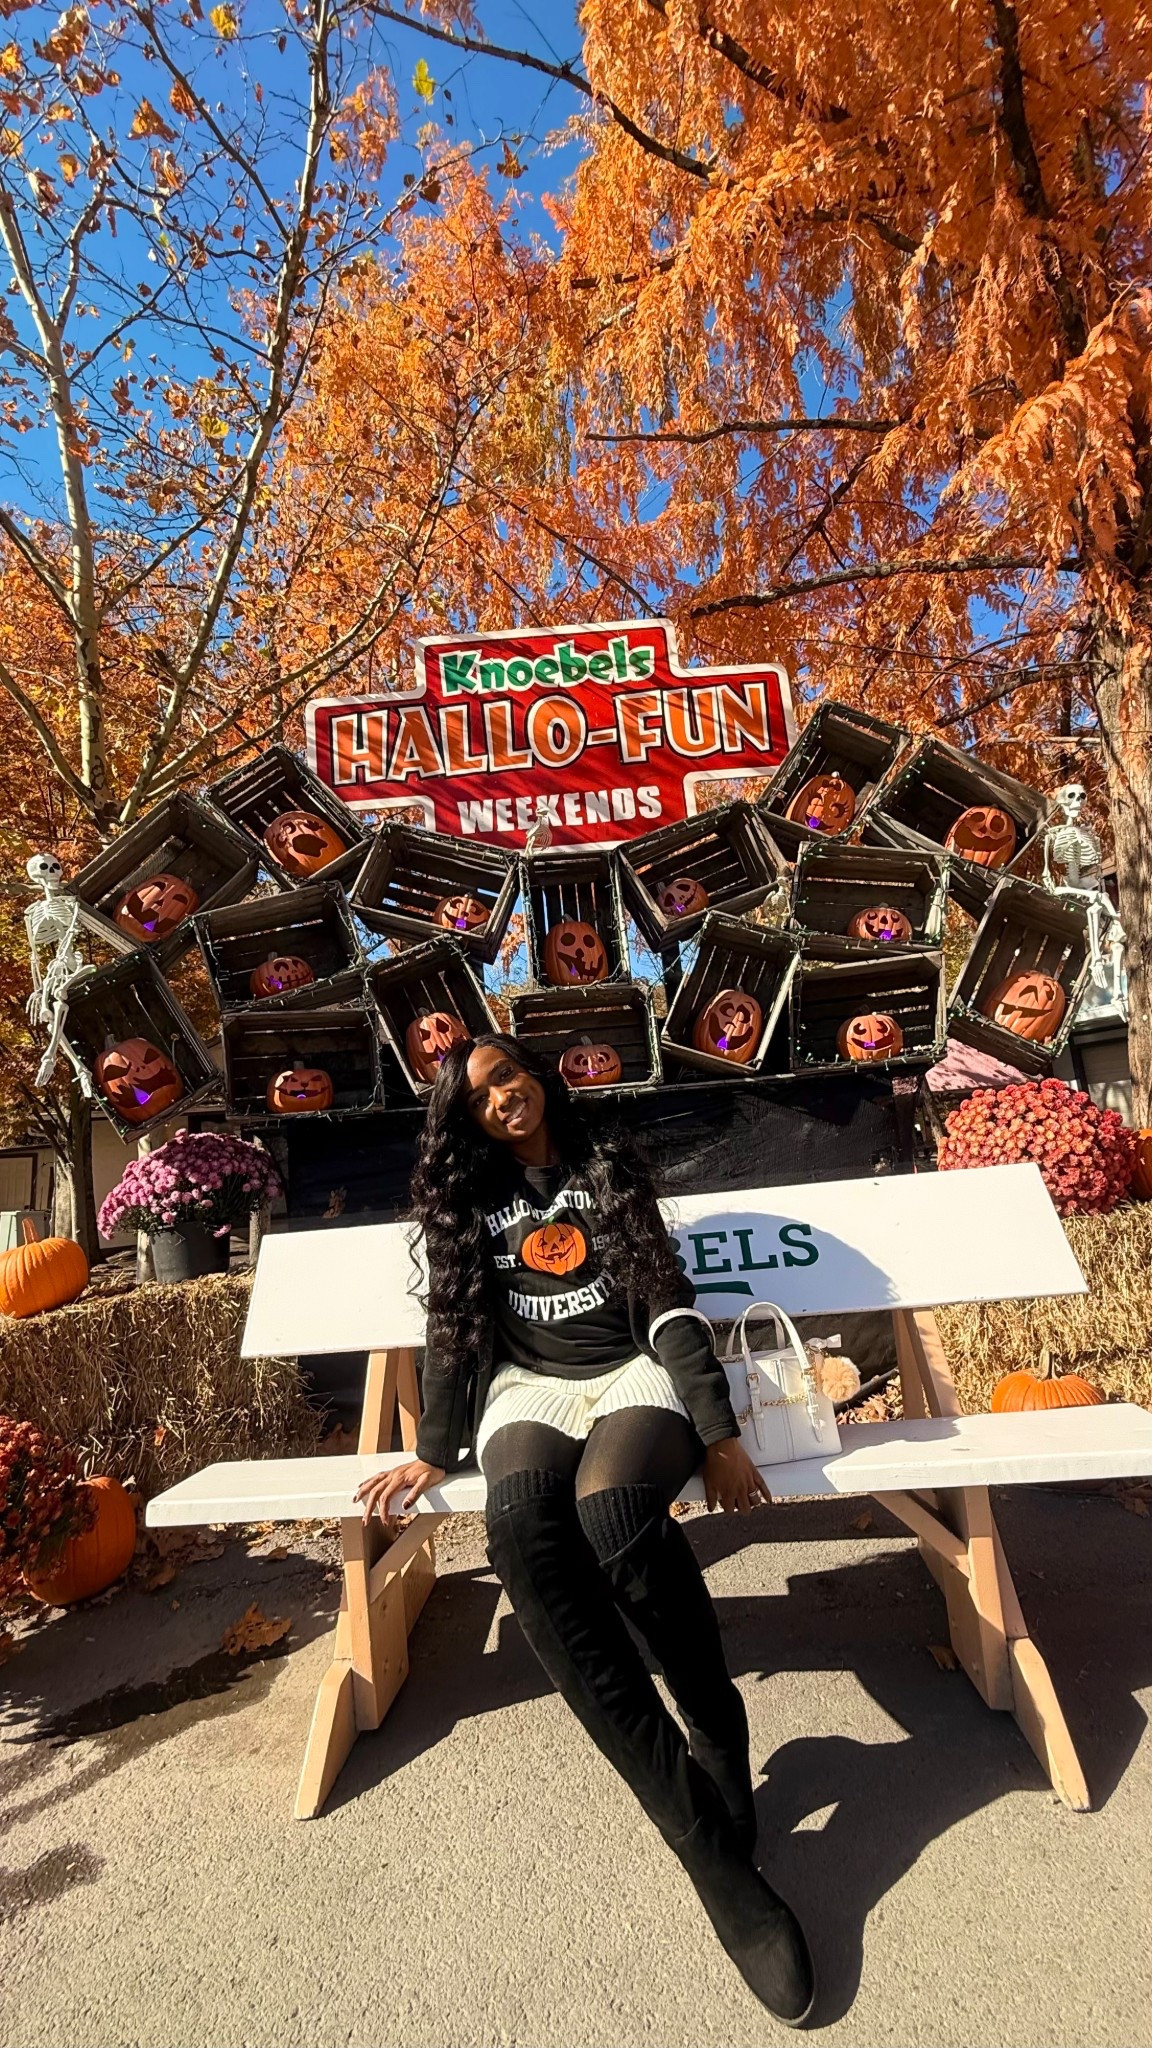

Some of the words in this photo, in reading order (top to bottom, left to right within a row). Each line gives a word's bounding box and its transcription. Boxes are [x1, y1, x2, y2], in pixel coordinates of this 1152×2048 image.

[440, 636, 655, 697] Knoebels
[331, 683, 770, 786] HALLO-FUN
[457, 785, 662, 835] WEEKENDS
[493, 1254, 522, 1269] EST.
[508, 1268, 616, 1321] UNIVERSITY
